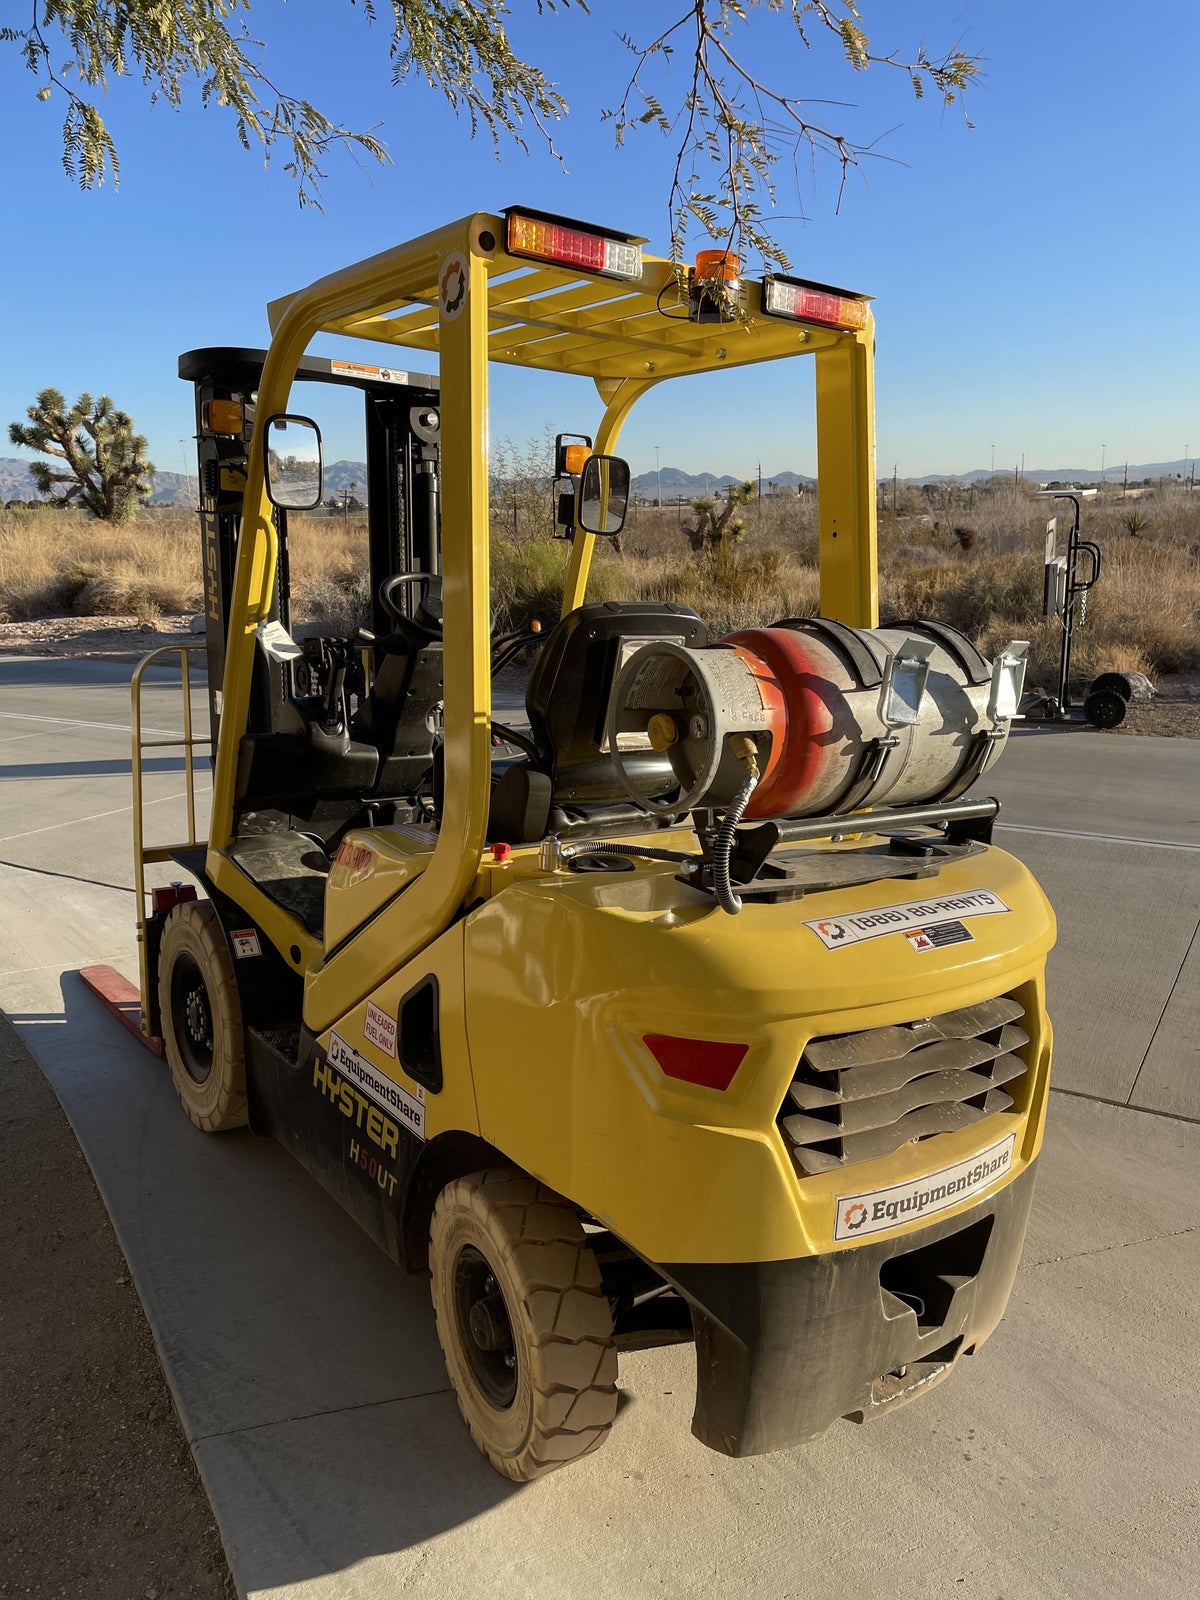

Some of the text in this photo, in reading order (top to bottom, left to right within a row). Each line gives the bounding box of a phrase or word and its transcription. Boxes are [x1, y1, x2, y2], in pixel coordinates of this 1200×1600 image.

[204, 497, 219, 620] HYSTE
[848, 893, 995, 931] (888) 80-RENTS
[365, 1022, 394, 1051] FUEL ONLY
[367, 1006, 395, 1036] UNLEADED
[312, 1056, 399, 1160] HYSTER
[339, 1047, 421, 1128] EquipmentShare
[349, 1138, 398, 1197] H50UT
[871, 1149, 1010, 1222] EquipmentShare
